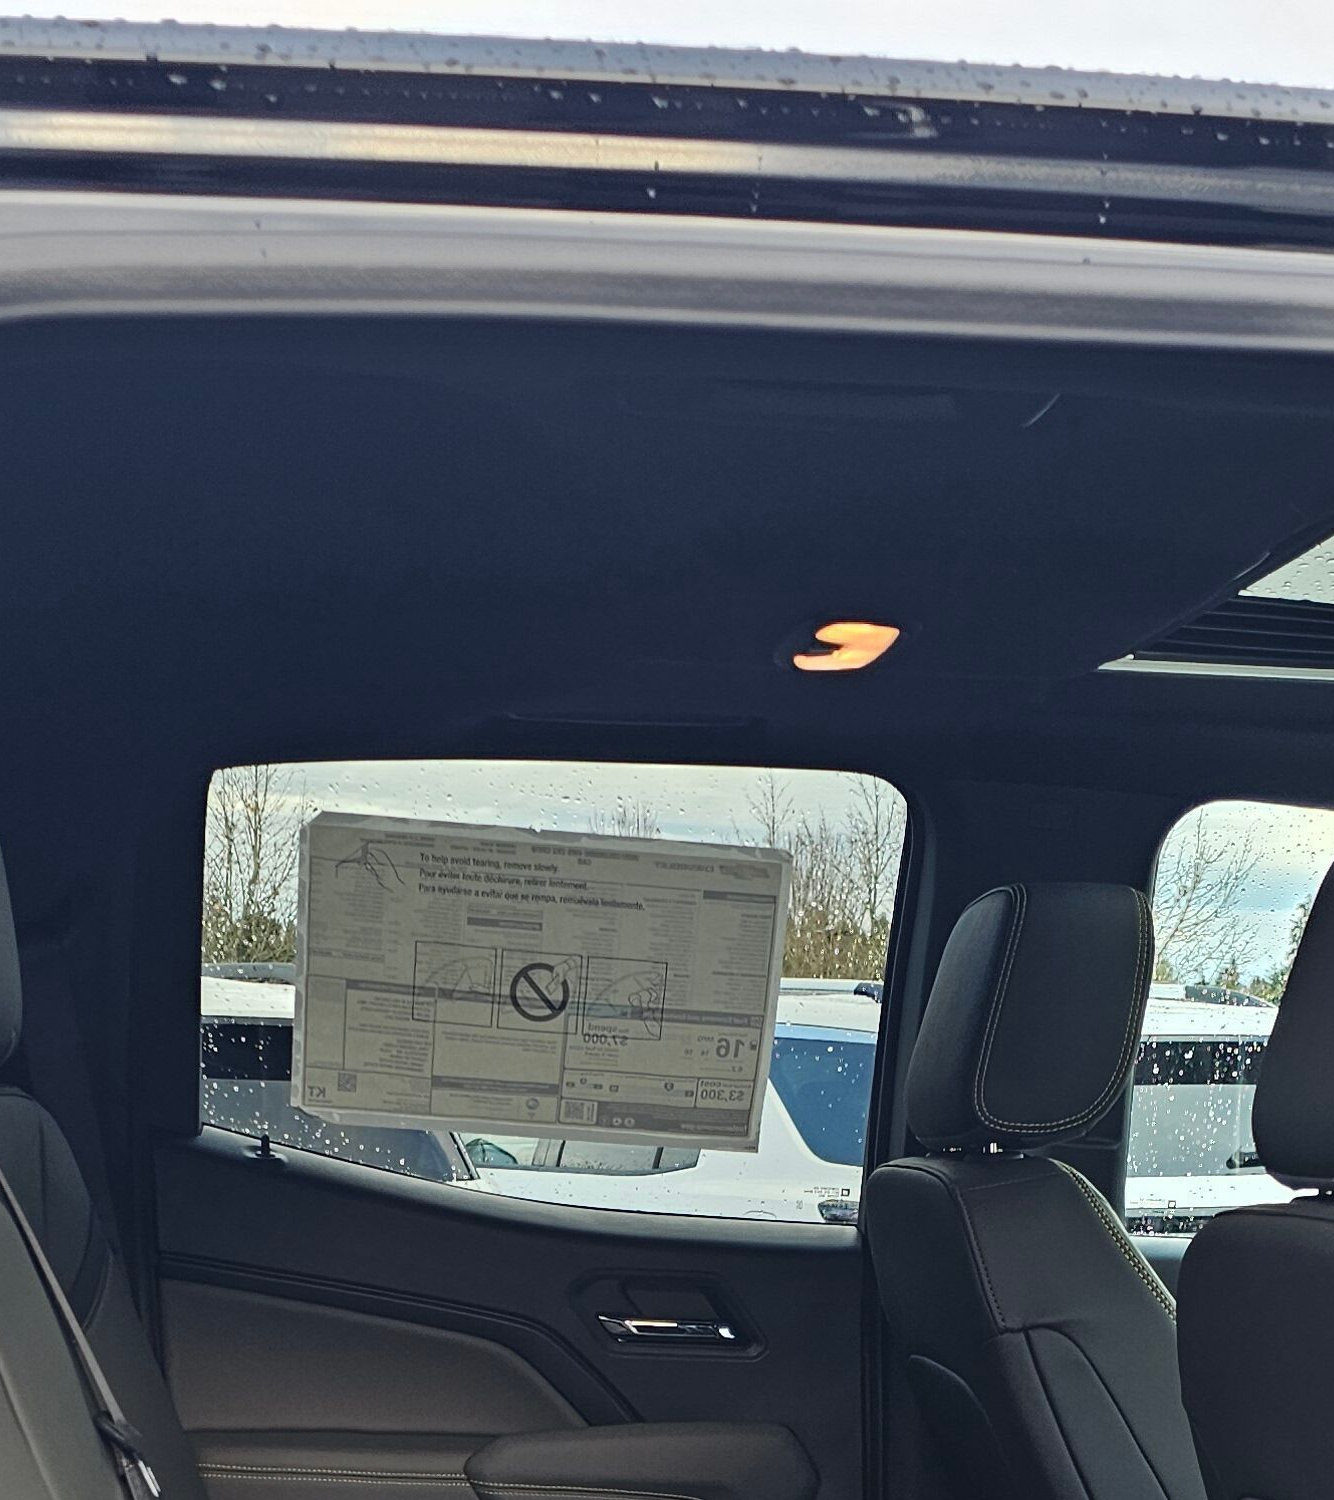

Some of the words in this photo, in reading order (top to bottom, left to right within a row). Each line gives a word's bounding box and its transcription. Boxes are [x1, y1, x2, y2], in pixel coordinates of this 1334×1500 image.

[420, 852, 430, 862] To
[431, 853, 449, 865] help
[450, 856, 471, 866] avoid
[504, 861, 533, 871] remove
[419, 867, 437, 878] Pour
[418, 882, 436, 893] Para
[474, 889, 480, 898] a
[504, 891, 519, 902] que
[520, 893, 530, 902] se
